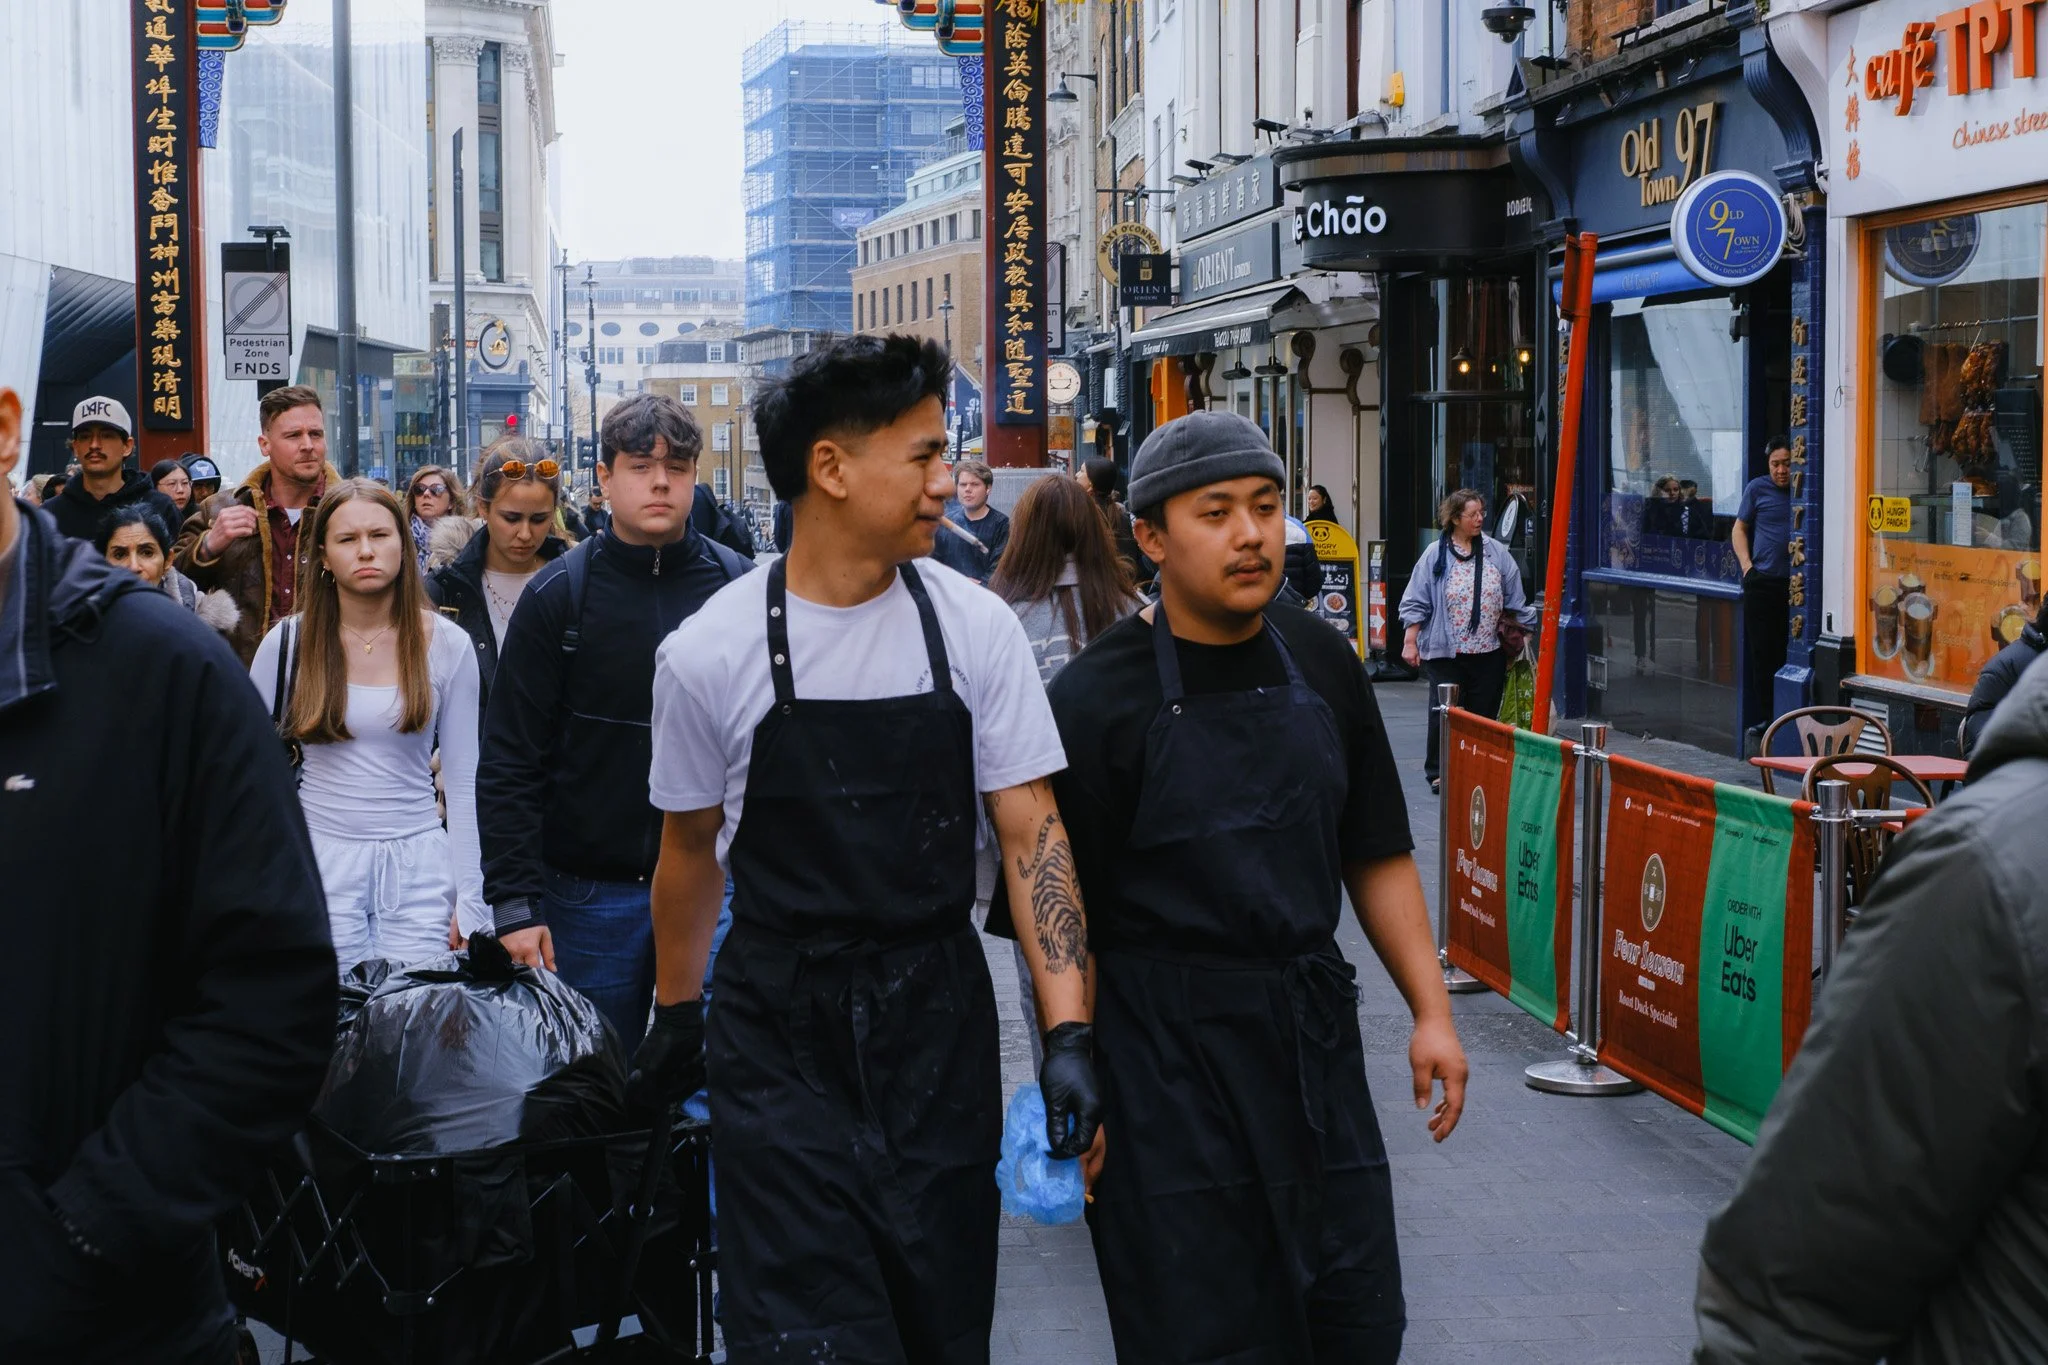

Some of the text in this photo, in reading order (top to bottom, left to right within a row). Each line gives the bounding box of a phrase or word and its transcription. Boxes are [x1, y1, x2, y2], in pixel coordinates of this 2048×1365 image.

[1865, 0, 2048, 117] café TPT
[1621, 101, 1718, 197] Old 97
[1952, 120, 2010, 150] Chinese
[1639, 172, 1677, 207] Town
[1306, 195, 1387, 238] Chão
[1100, 229, 1119, 254] WAXY
[1197, 246, 1235, 291] ORIENT
[1699, 250, 1772, 275] LUNCH DINNER SUPPER
[1123, 285, 1167, 294] ORIENT
[1622, 271, 1660, 291] Old Town 97
[229, 338, 285, 347] Pedestrian
[244, 348, 270, 358] Zone
[234, 362, 281, 375] FNDS
[81, 401, 112, 418] LAFC
[1886, 507, 1908, 517] HUNGRY
[1518, 839, 1541, 873] Uber
[1517, 870, 1539, 903] Eats
[1727, 898, 1748, 917] ORDER
[1613, 928, 1685, 986] Four Seasons
[1724, 922, 1758, 964] Uber
[1721, 960, 1757, 1003] Eats
[1618, 988, 1678, 1030] Roast Duck Specialist
